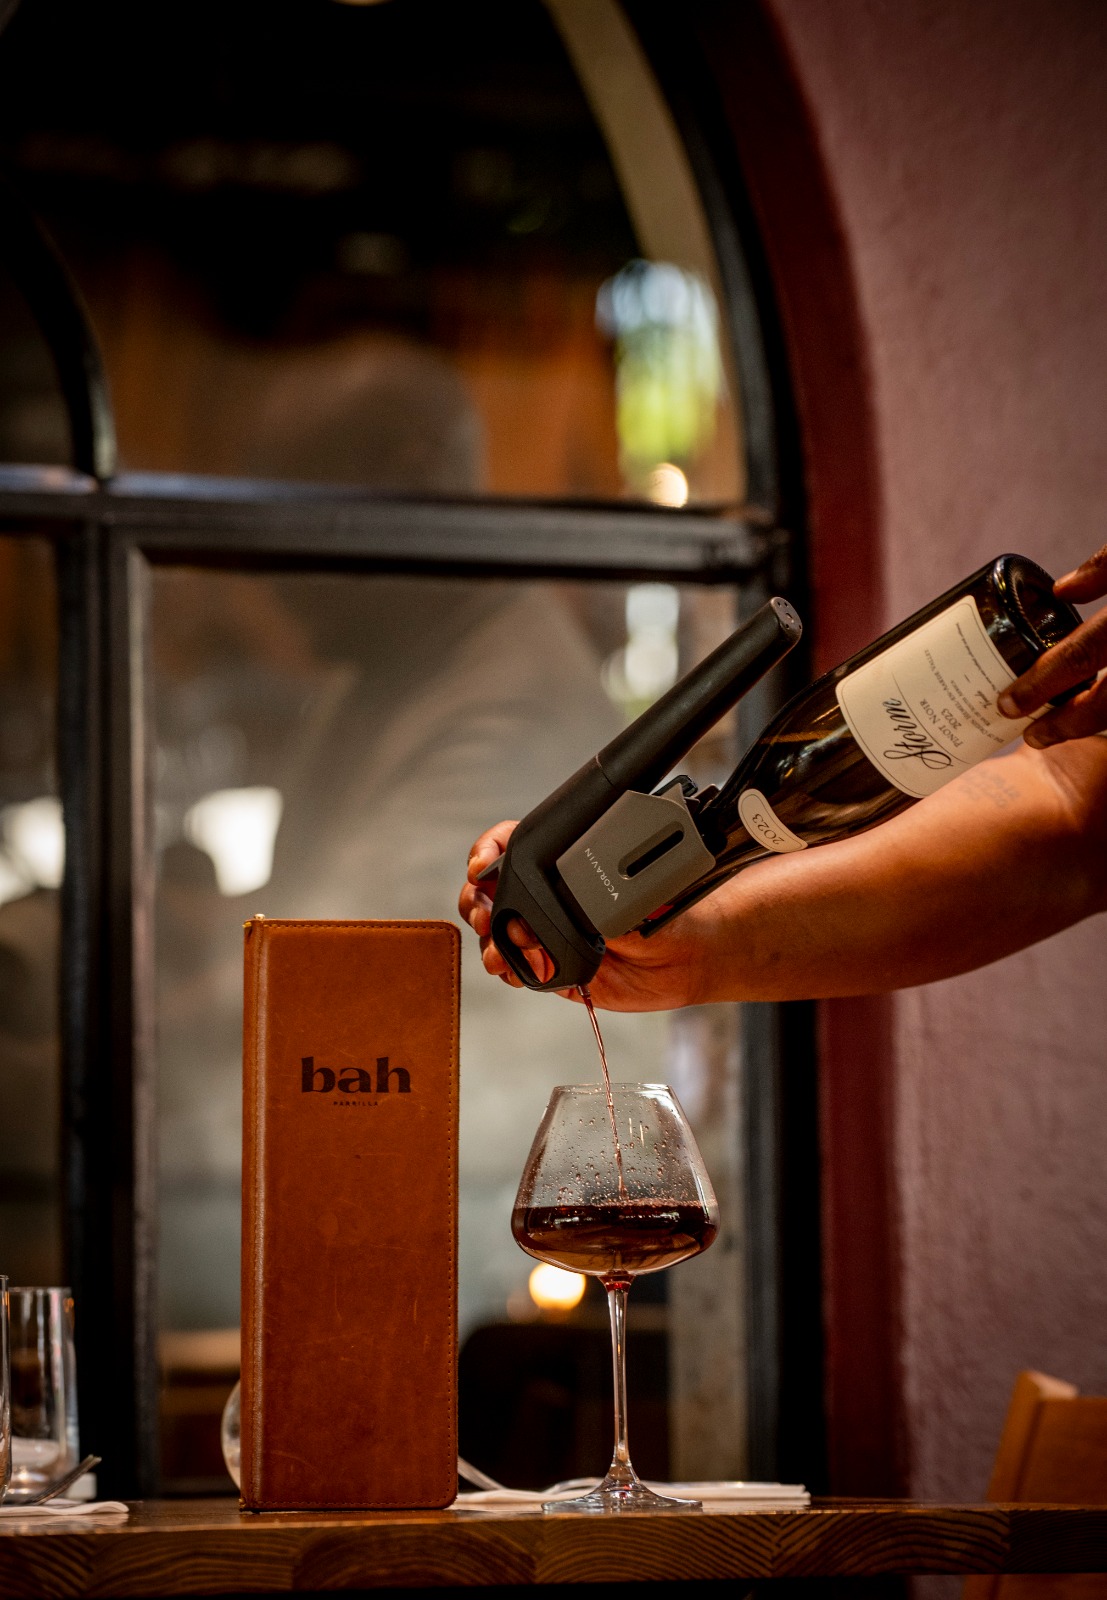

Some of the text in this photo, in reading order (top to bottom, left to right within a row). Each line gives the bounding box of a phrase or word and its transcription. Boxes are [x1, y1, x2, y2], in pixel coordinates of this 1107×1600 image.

[882, 698, 954, 770] Storm
[920, 698, 963, 748] PINOT NOIR
[941, 708, 962, 730] 2023
[752, 813, 785, 845] 2023
[584, 847, 616, 894] CORAVIN
[301, 1056, 411, 1094] bah
